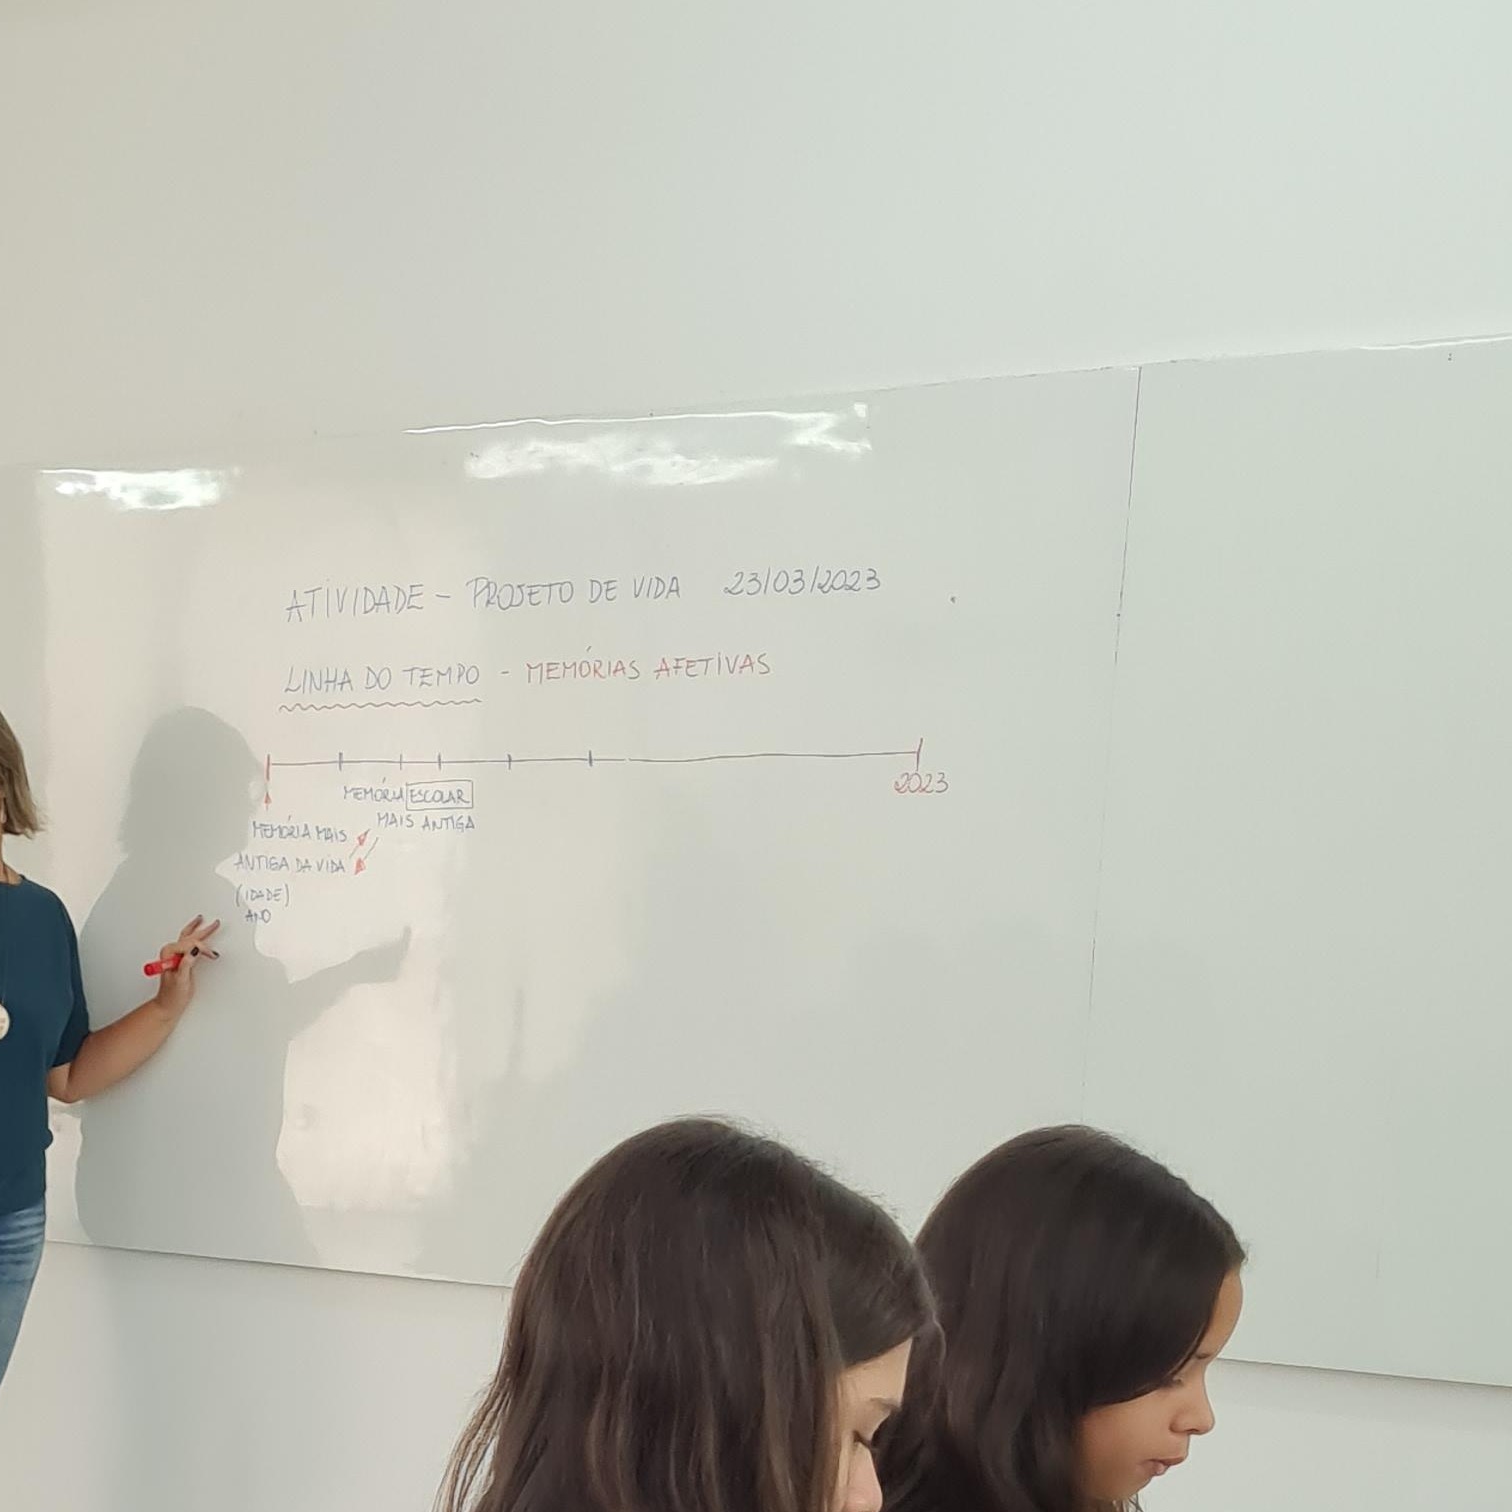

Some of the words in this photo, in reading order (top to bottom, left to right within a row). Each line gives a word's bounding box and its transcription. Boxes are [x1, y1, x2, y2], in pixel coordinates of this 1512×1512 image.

[285, 579, 425, 622] ATIVIDADE
[466, 576, 575, 611] PROJETO
[588, 578, 618, 604] DE
[633, 575, 681, 600] VIDA
[722, 565, 881, 596] 23/03/2023
[284, 666, 354, 694] LINHA
[365, 665, 393, 691] DO
[402, 662, 480, 688] TEMPO
[526, 646, 641, 684] MEMÓRIAS
[653, 652, 772, 680] AFETIVAS
[893, 771, 949, 794] 2023
[409, 787, 471, 804] ESCOLAR
[252, 815, 311, 840] MEMÓRIA
[315, 826, 348, 843] MAIS
[377, 812, 415, 829] MAIS
[421, 815, 476, 833] ANTIGA
[234, 853, 290, 872] ANTIGA
[295, 858, 313, 873] DA
[317, 858, 346, 874] VIDA
[235, 883, 290, 907] (IDADE)
